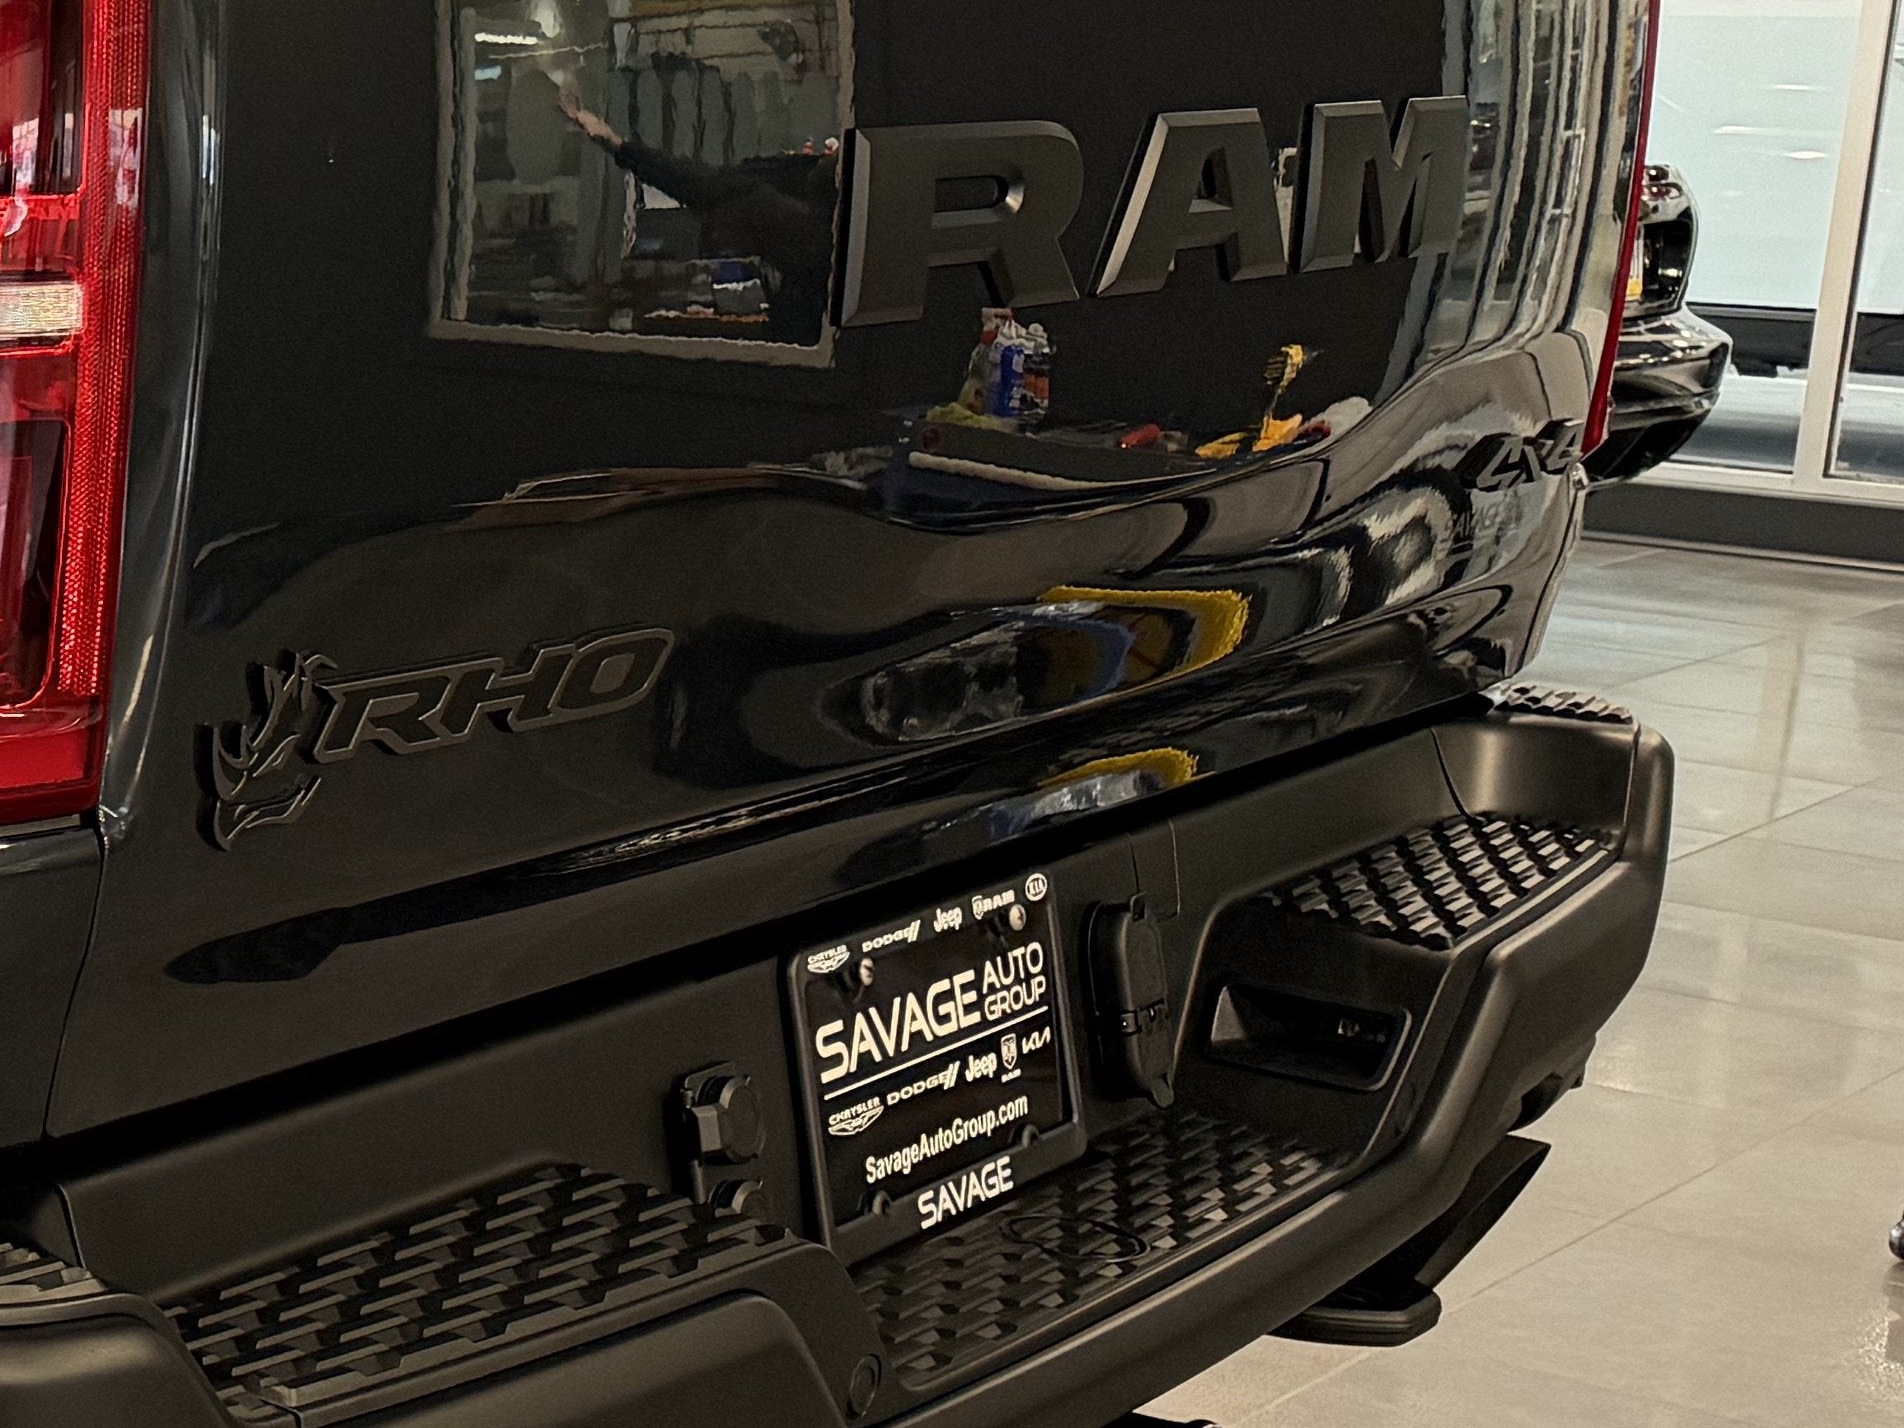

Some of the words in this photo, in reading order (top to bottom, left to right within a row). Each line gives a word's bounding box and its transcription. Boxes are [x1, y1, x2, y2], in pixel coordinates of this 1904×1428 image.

[830, 95, 1469, 329] RAM
[304, 623, 676, 764] RHO
[862, 922, 916, 953] DODGE
[933, 907, 962, 932] Jeep
[982, 889, 1015, 912] RAM
[982, 941, 1044, 994] AUTO
[984, 975, 1047, 1021] GROUP
[815, 969, 981, 1084] SAVAGE
[828, 1097, 880, 1125] CHRYSLER
[887, 1066, 952, 1105] DODGE
[965, 1052, 997, 1082] Jeep
[865, 1095, 1029, 1184] SavageAutoGroup.com
[917, 1155, 1014, 1230] SAVAGE
